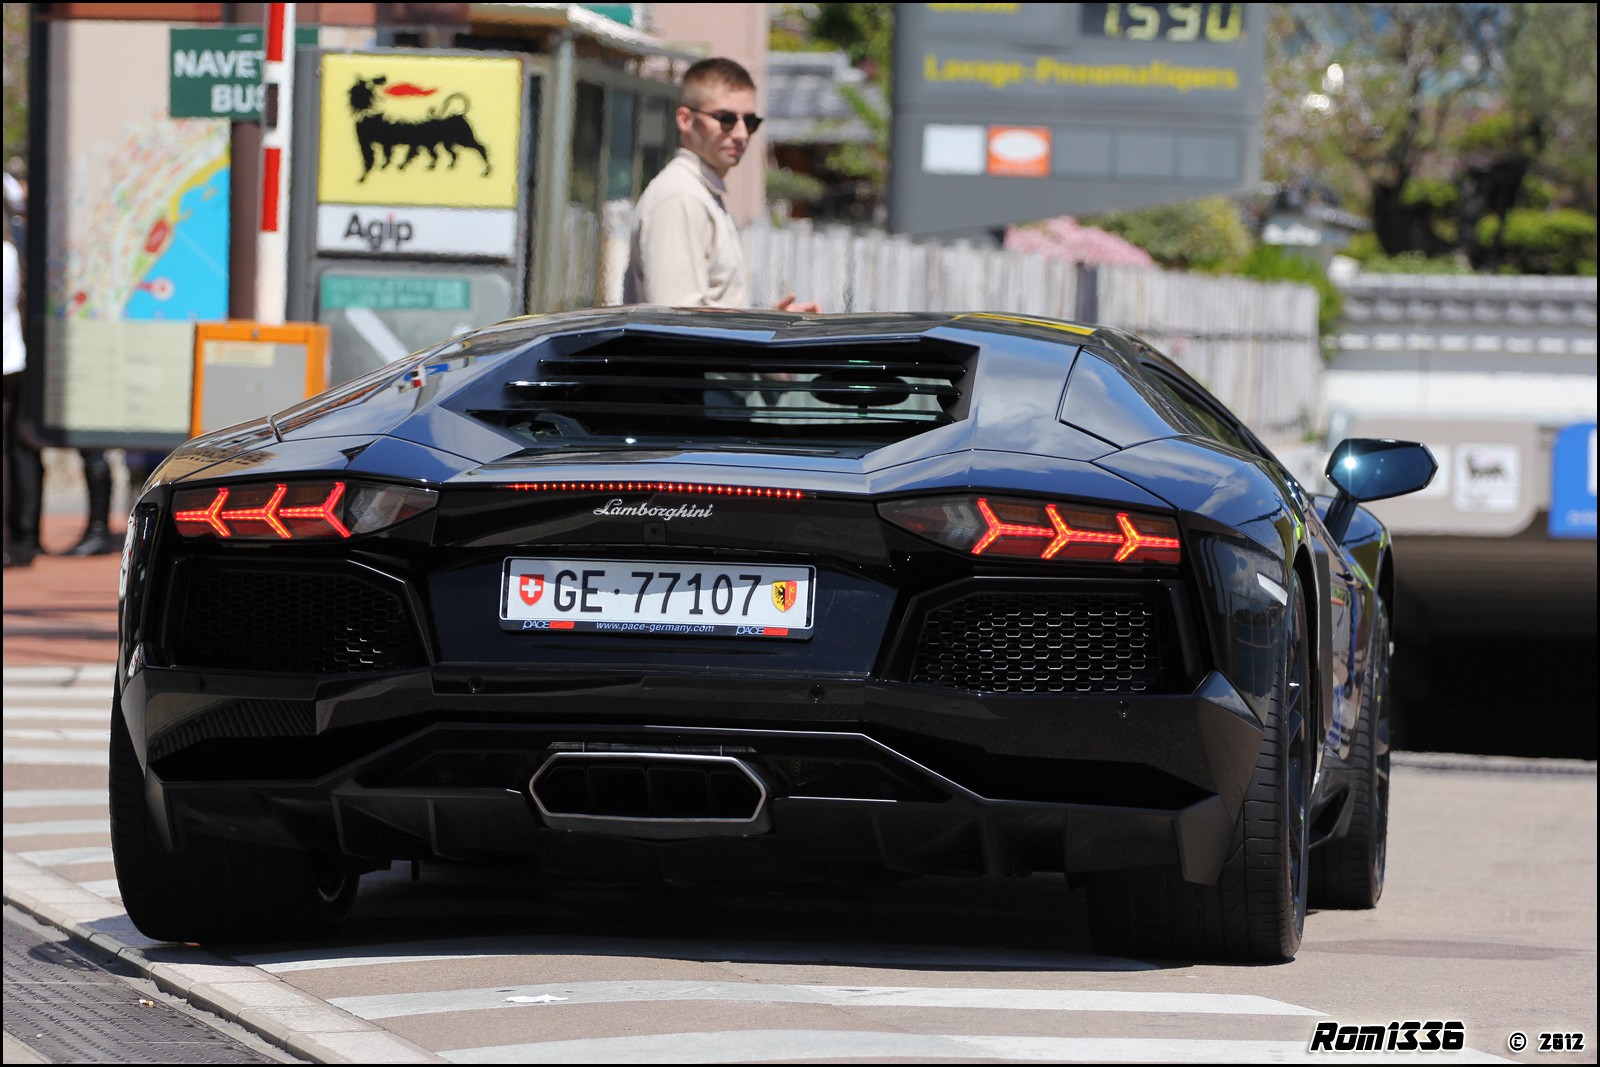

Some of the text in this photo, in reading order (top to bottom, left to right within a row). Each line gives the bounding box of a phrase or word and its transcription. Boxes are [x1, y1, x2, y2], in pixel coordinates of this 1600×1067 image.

[344, 212, 413, 250] Agip
[592, 498, 713, 521] Lamborghini
[595, 621, 715, 634] www.pace-germany.com
